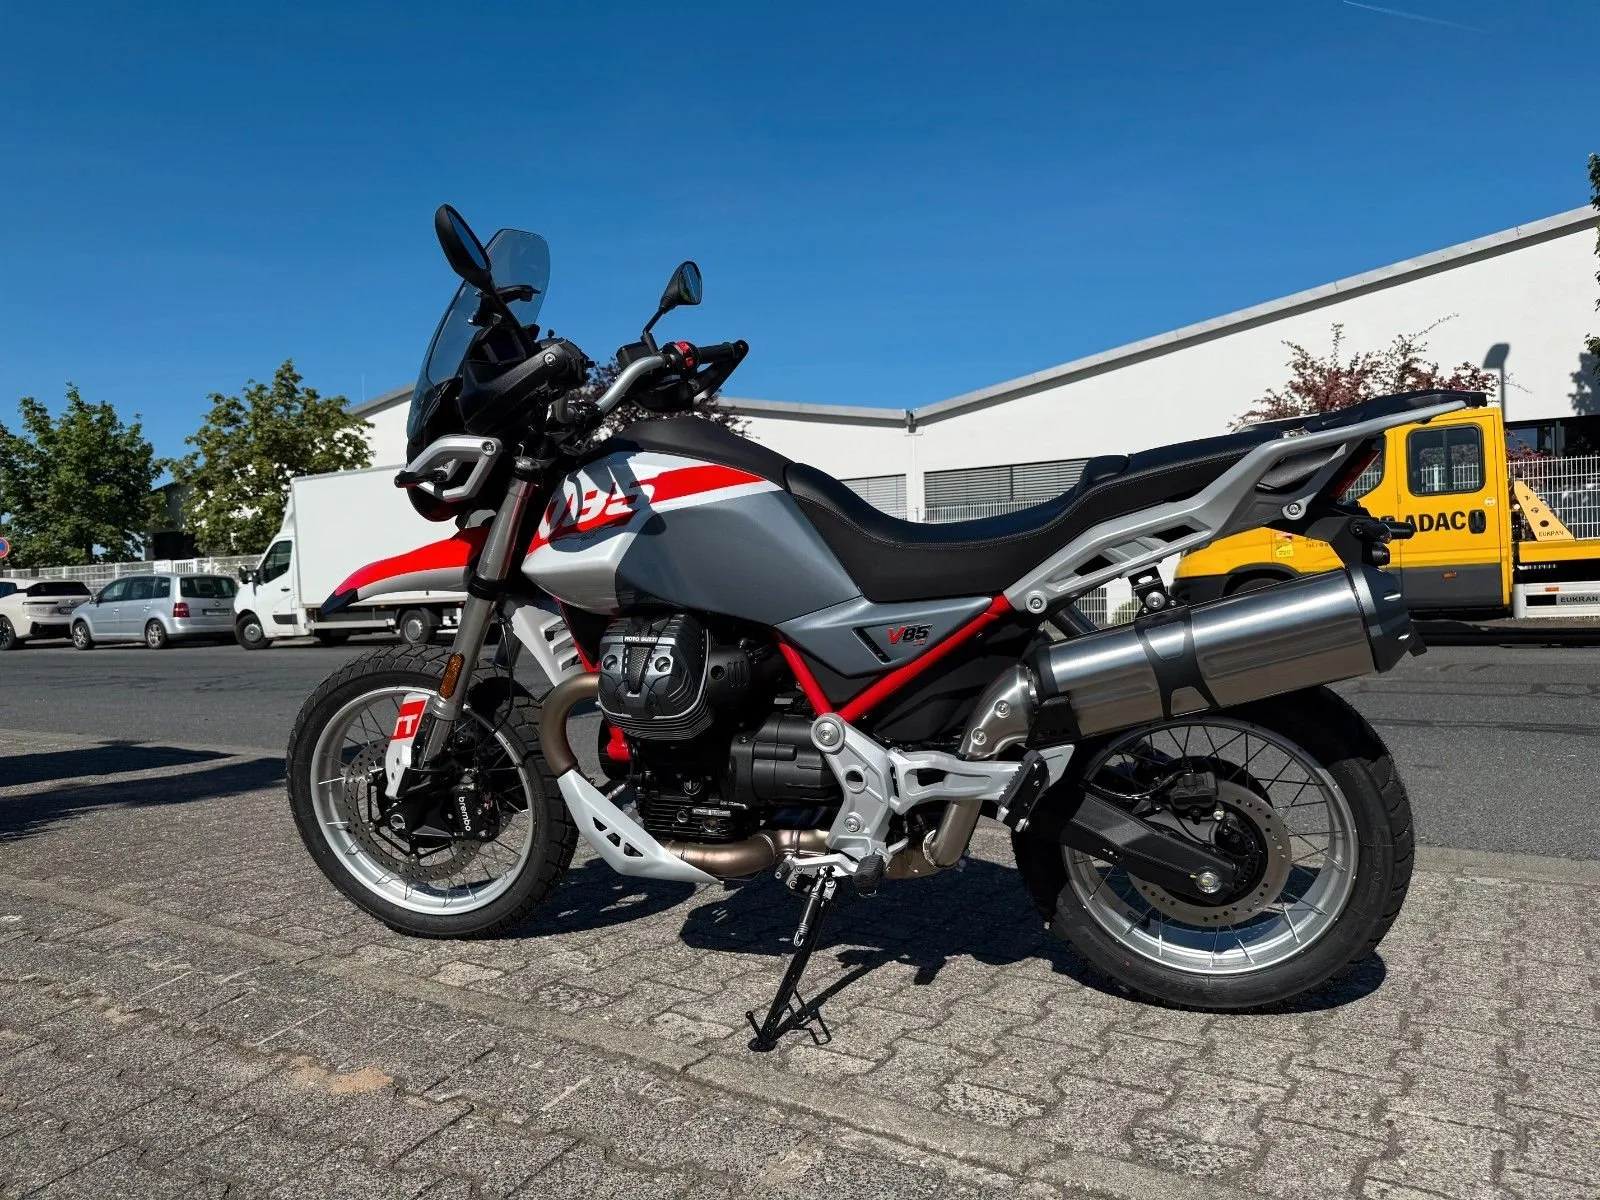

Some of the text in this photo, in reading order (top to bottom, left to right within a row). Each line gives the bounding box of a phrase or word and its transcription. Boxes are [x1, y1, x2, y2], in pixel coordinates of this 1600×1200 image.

[1403, 511, 1467, 533] ADAC
[887, 623, 932, 645] V85
[458, 796, 472, 832] brembo
